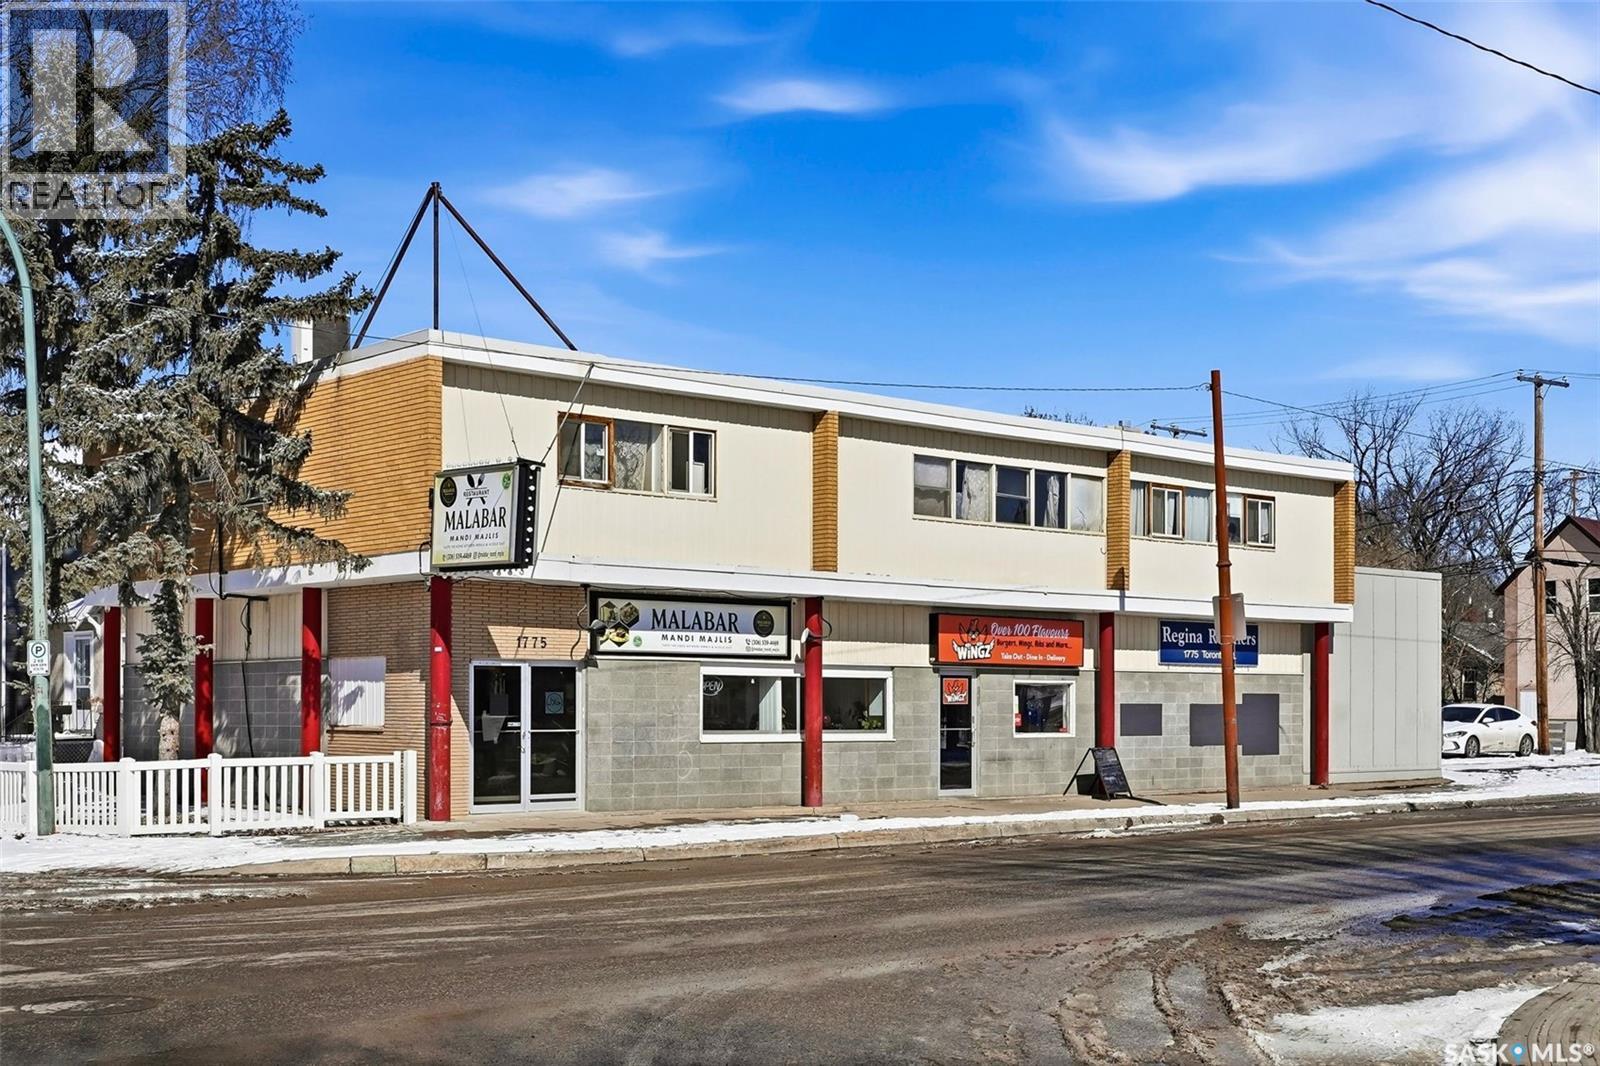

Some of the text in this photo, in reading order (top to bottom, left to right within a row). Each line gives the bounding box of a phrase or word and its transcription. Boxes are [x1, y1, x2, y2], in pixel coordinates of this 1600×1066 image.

[463, 489, 490, 497] RESTAURANT
[444, 506, 507, 532] MALABAR
[450, 532, 499, 542] MANDI MAJLIS
[651, 608, 740, 634] MALABAR
[990, 622, 1070, 639] Over 100 Flavours
[661, 634, 733, 644] MANDI MAJLIS
[1162, 626, 1203, 647] Regina
[517, 636, 547, 649] 1775
[1046, 640, 1055, 648] and
[1013, 652, 1023, 660] Out
[1046, 654, 1066, 663] Delivery
[1183, 649, 1199, 659] 1775
